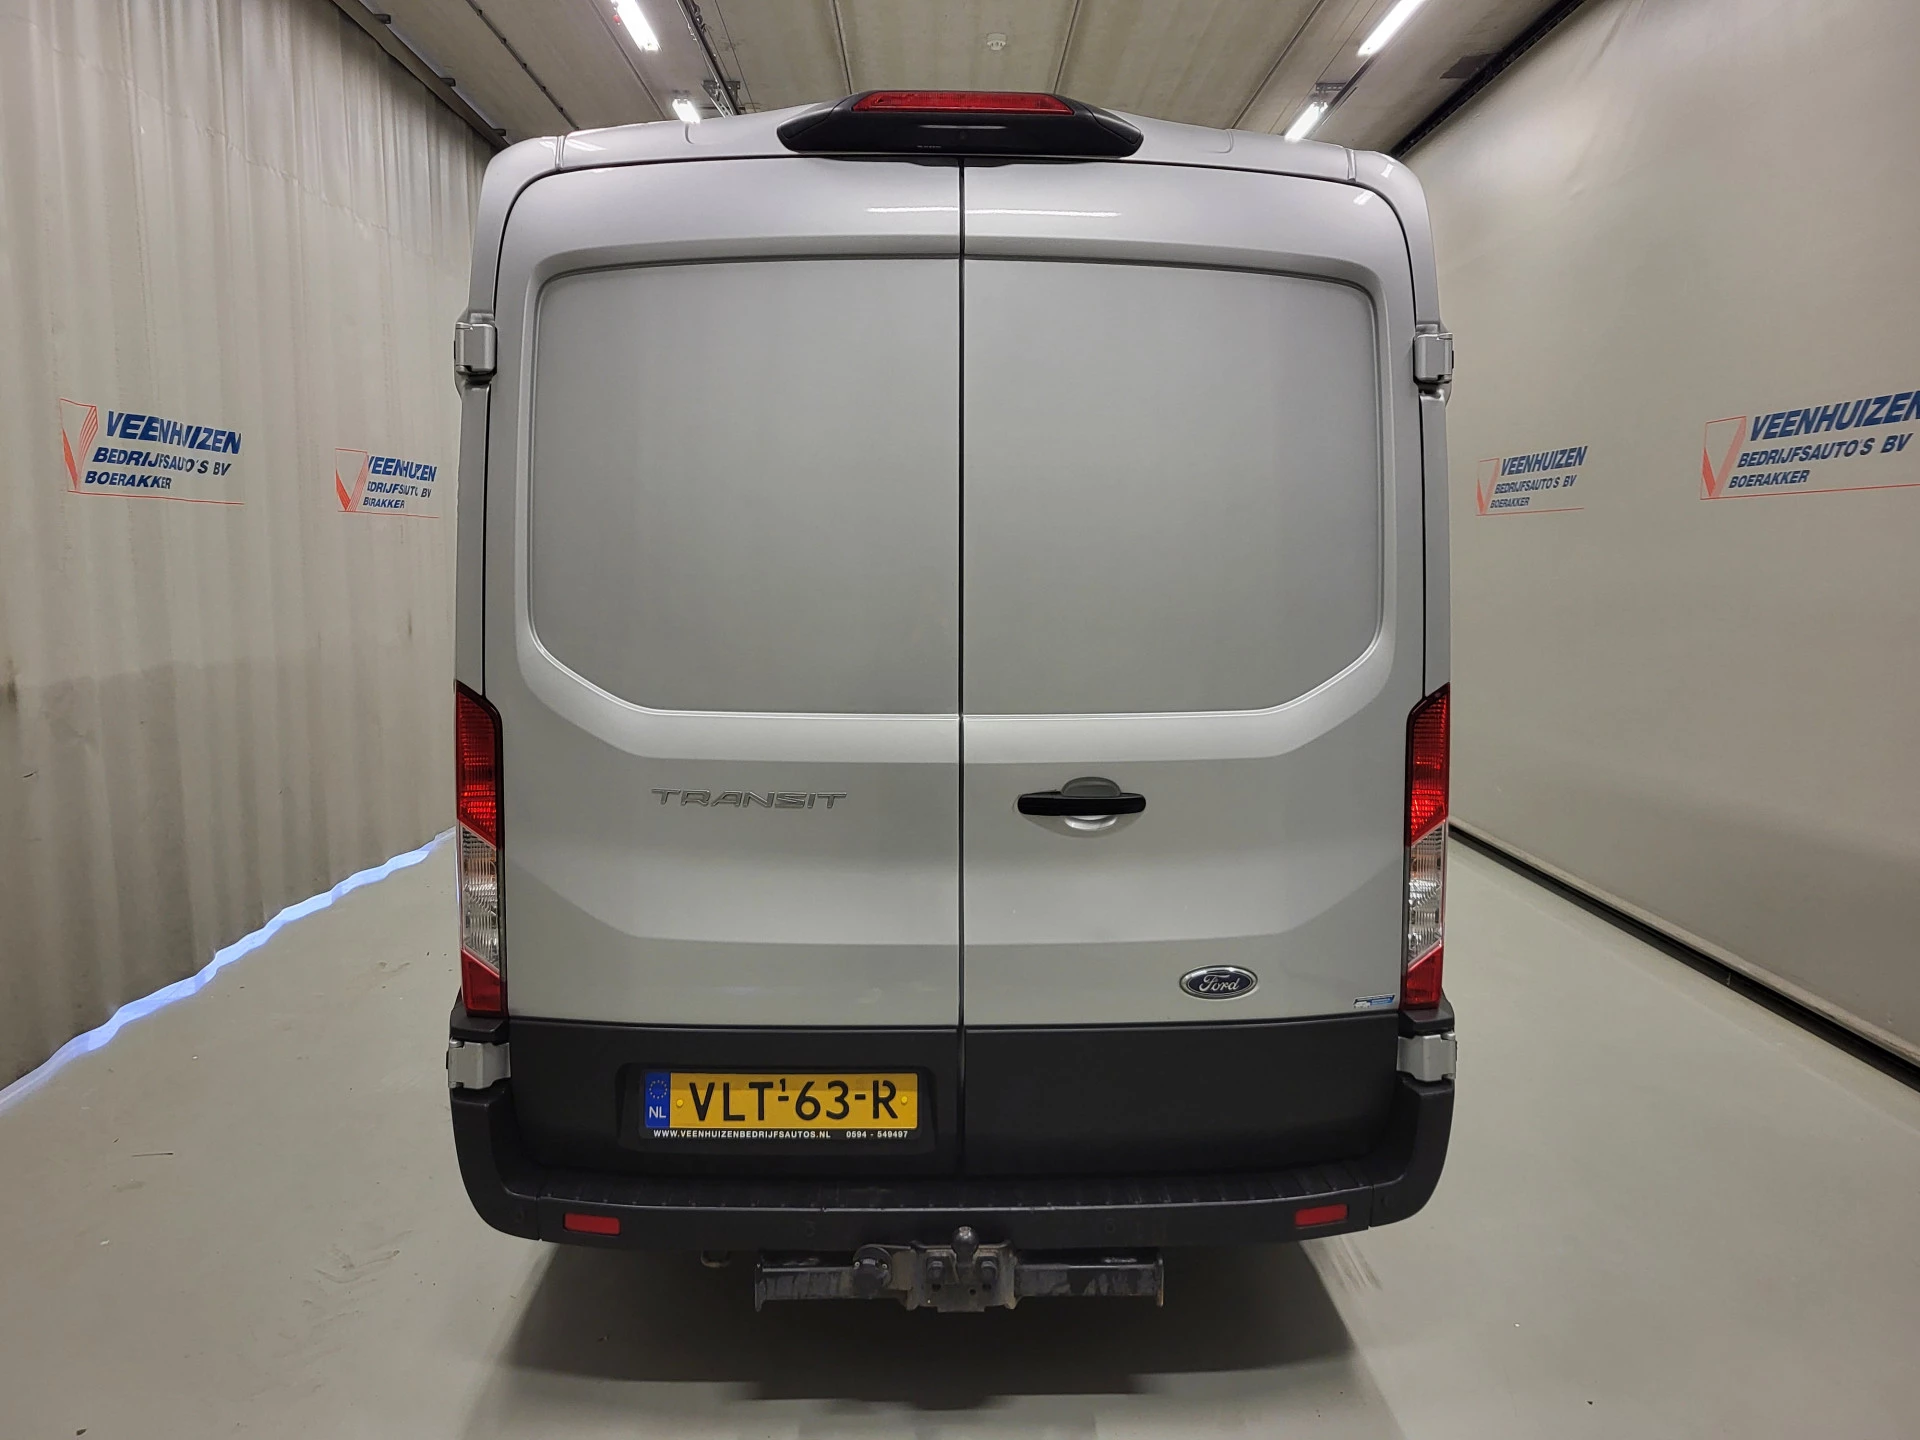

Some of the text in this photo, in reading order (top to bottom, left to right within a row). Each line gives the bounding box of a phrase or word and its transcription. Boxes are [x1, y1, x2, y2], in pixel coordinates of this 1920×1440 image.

[1501, 445, 1588, 476] VEENHUIZEN
[1737, 433, 1914, 468] BEDRIJFSAUTO'S BV
[92, 446, 232, 476] BEDRIJFSAUO'S BV
[84, 470, 172, 490] BOERAKKER
[1494, 474, 1577, 494] BEDRIJFSAUTO'S BV
[1728, 470, 1810, 489] BOERAKKER
[1490, 497, 1530, 508] BOERAKKER
[651, 788, 848, 809] TRANSIT
[1199, 974, 1241, 992] Ford
[648, 1106, 666, 1119] NL
[653, 1129, 831, 1139] WWW.VEENHUIZENBEDRIJFSAUTOS.NL
